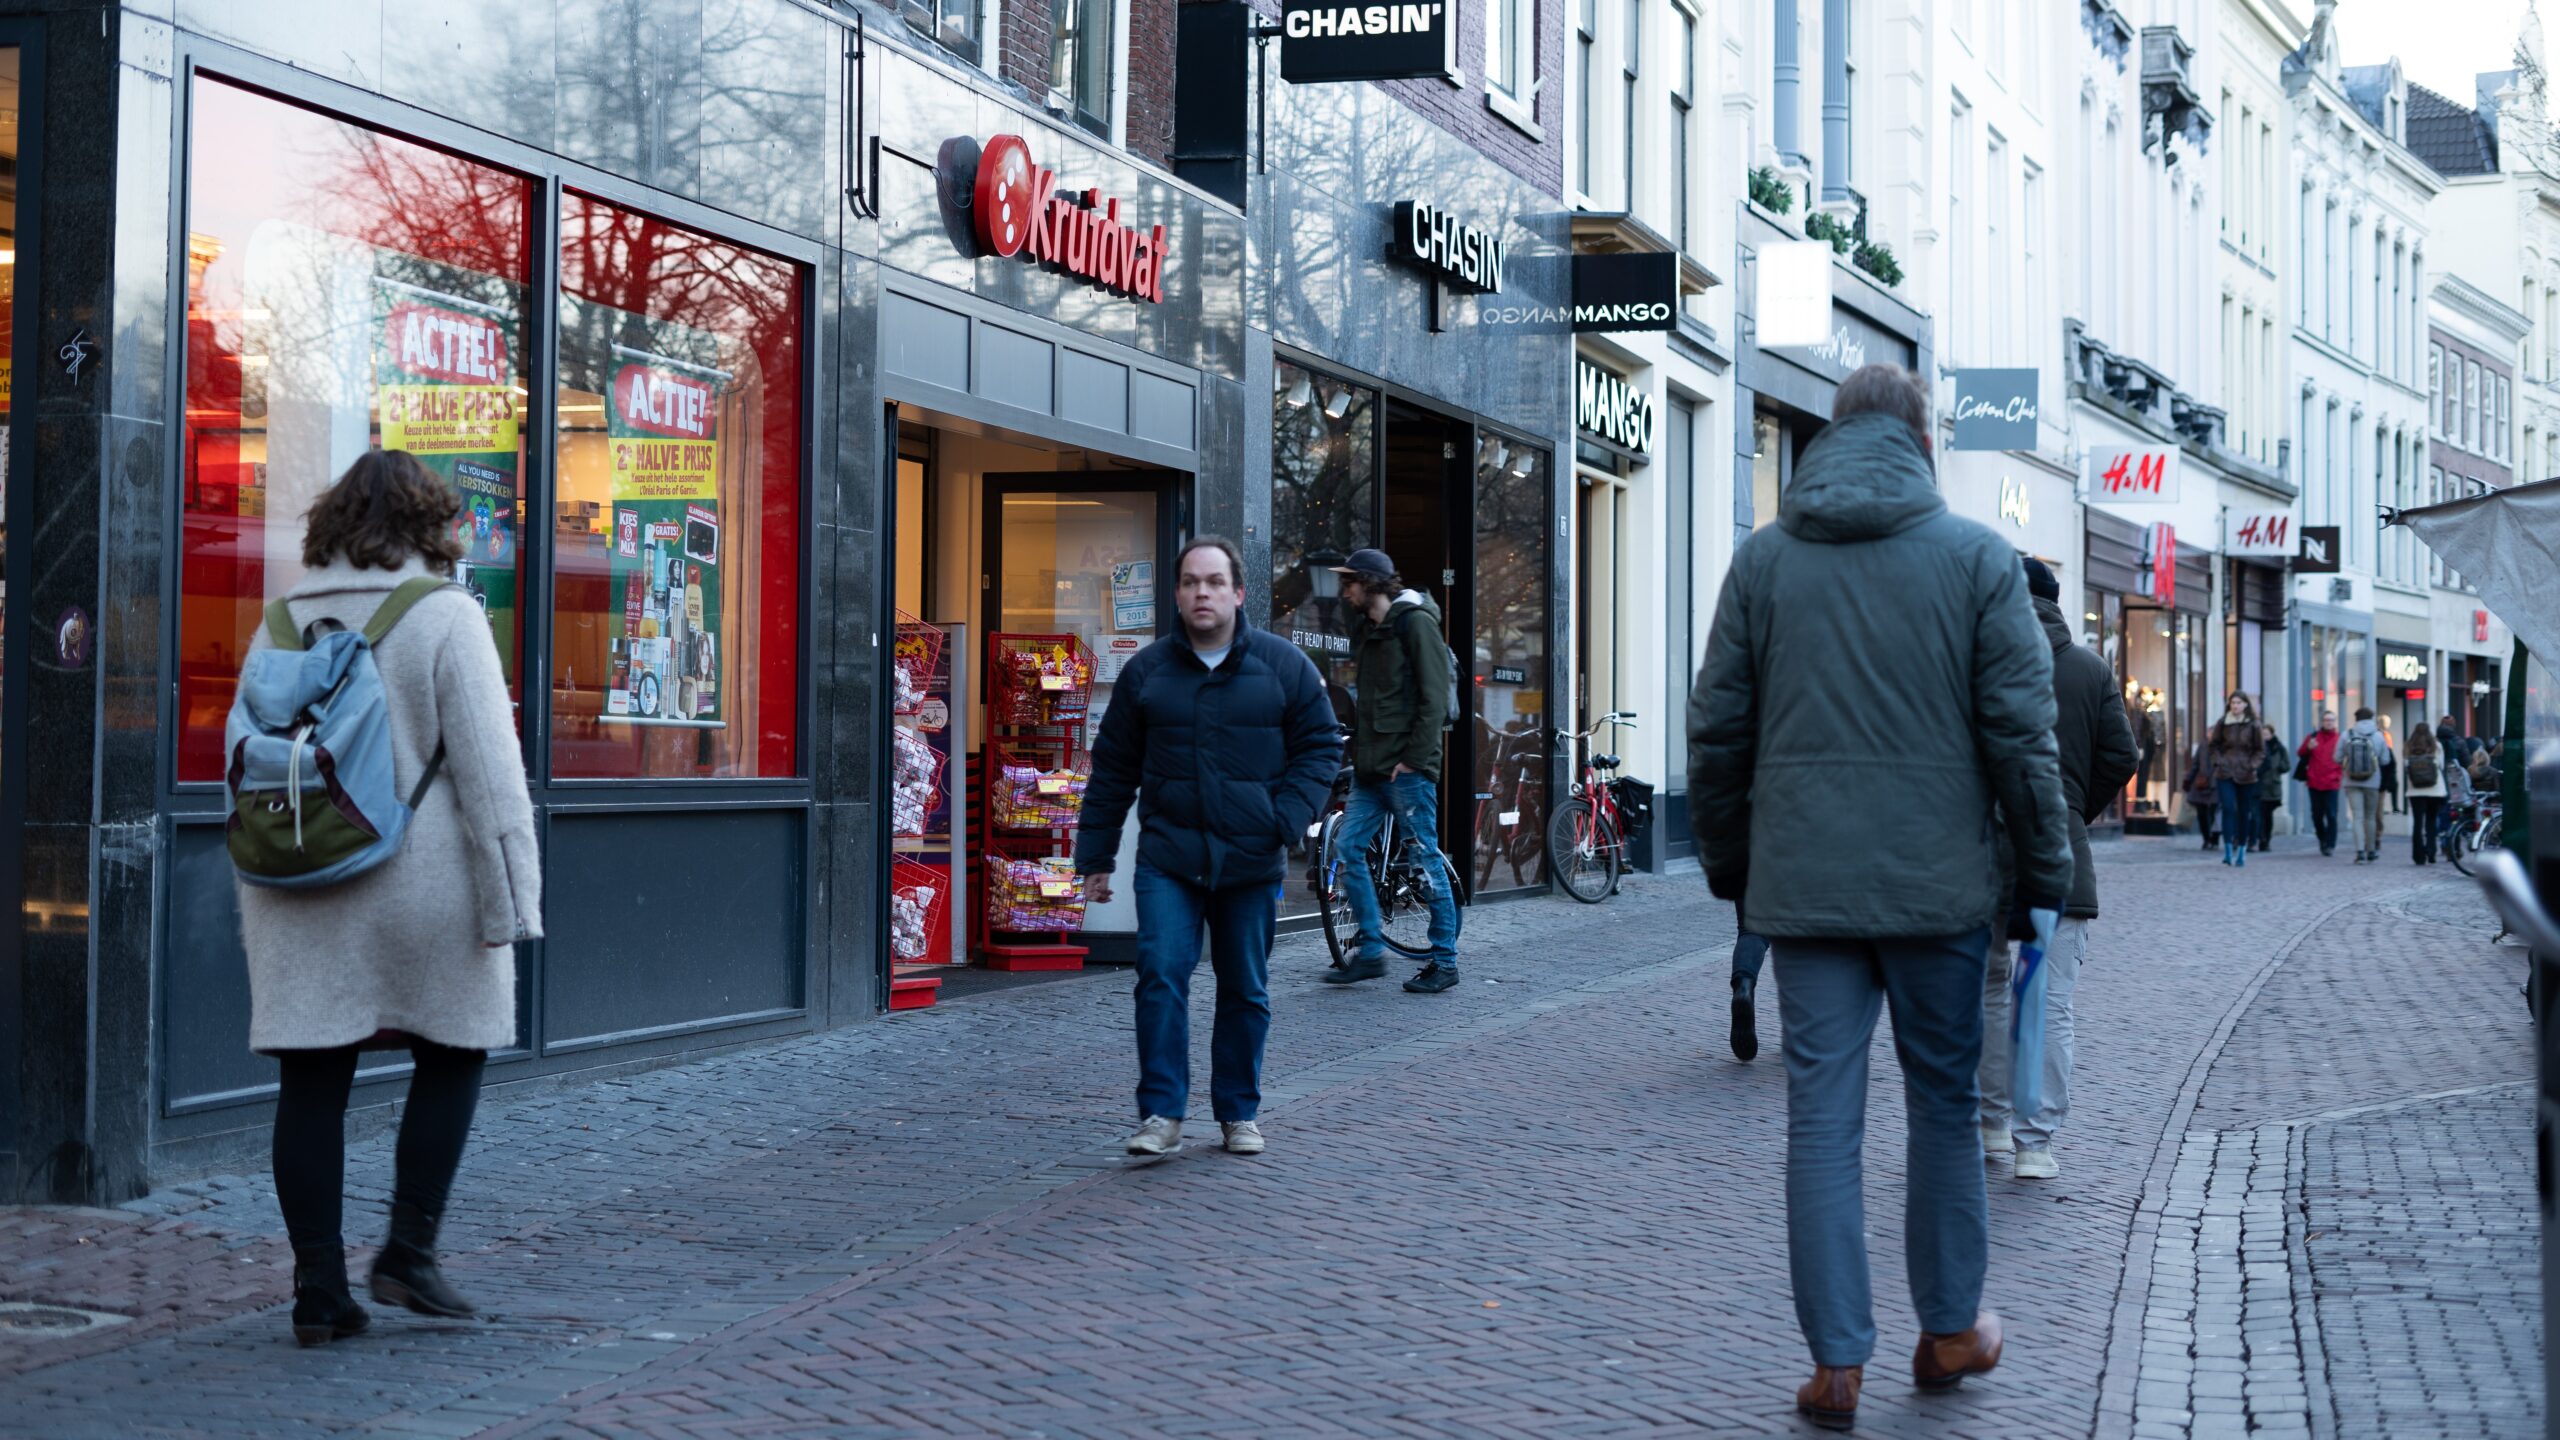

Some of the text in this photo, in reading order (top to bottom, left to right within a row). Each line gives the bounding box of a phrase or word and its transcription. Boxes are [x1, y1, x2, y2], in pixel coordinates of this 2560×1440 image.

[1286, 3, 1441, 38] CHASIN'
[1029, 164, 1169, 304] Kruidvat
[1575, 303, 1670, 322] MANGO
[402, 311, 497, 381] ACTIE!
[410, 391, 459, 422] HALVE
[464, 391, 513, 421] PRIJS
[628, 373, 707, 436] ACTIE!
[1580, 361, 1655, 454] MANGO
[2005, 396, 2036, 423] Club
[404, 424, 422, 436] Keuze
[636, 444, 680, 471] HALVE
[683, 445, 713, 471] PRIJS
[2101, 452, 2166, 494] H&M
[620, 512, 638, 527] KIES
[655, 525, 679, 537] GRATIS!
[2237, 515, 2288, 548] H&M
[620, 540, 636, 555] MIX
[1127, 611, 1147, 621] 2018
[1292, 630, 1350, 653] GET READY TO PARTY
